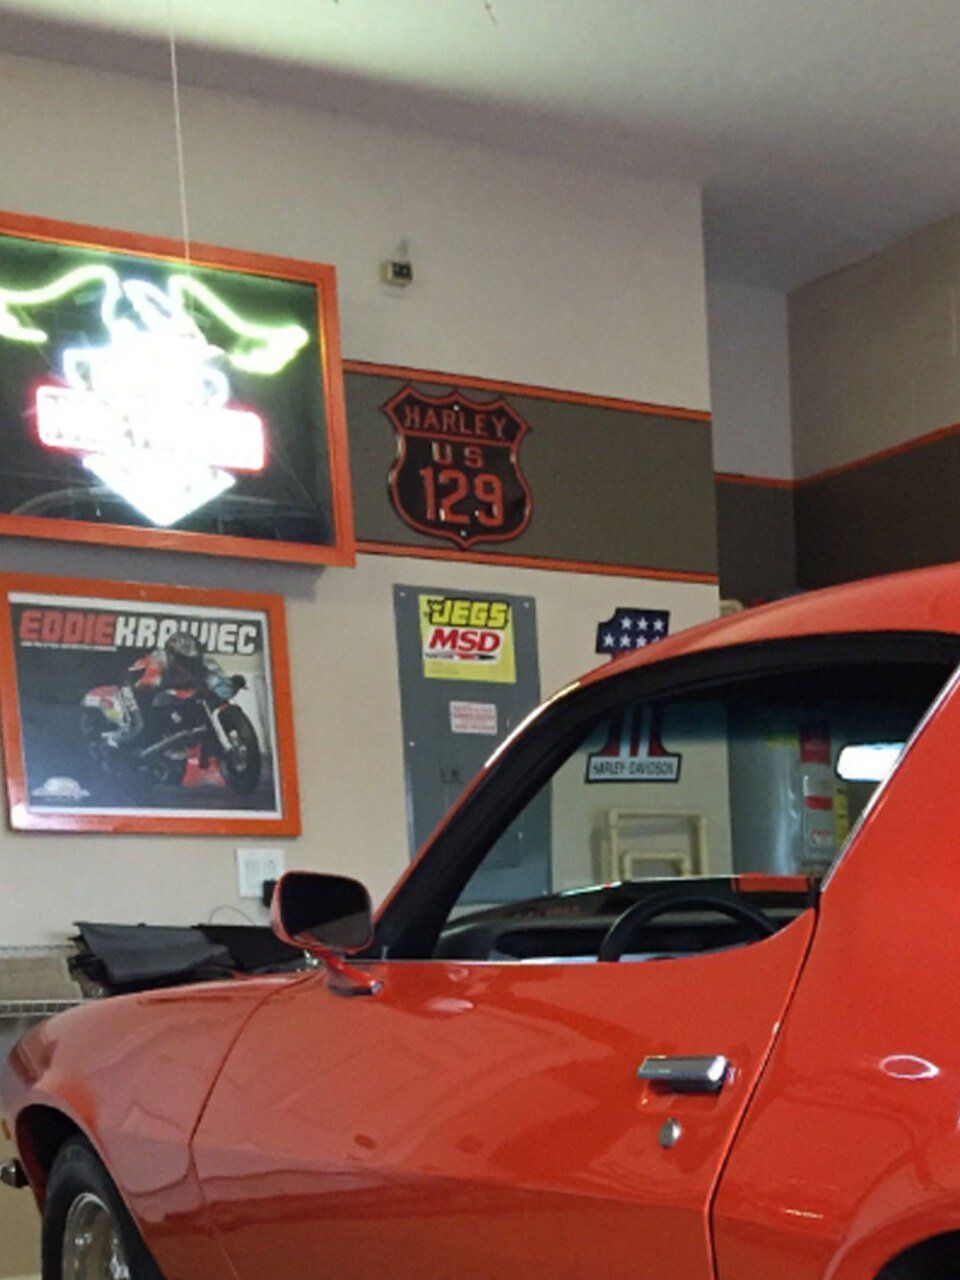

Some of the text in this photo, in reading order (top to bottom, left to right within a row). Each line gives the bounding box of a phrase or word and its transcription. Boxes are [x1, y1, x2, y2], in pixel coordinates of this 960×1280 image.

[404, 405, 507, 438] HARLEY
[419, 467, 505, 528] 129
[19, 608, 116, 645] EDDIE
[429, 598, 508, 629] JEGS
[429, 627, 501, 652] MSD
